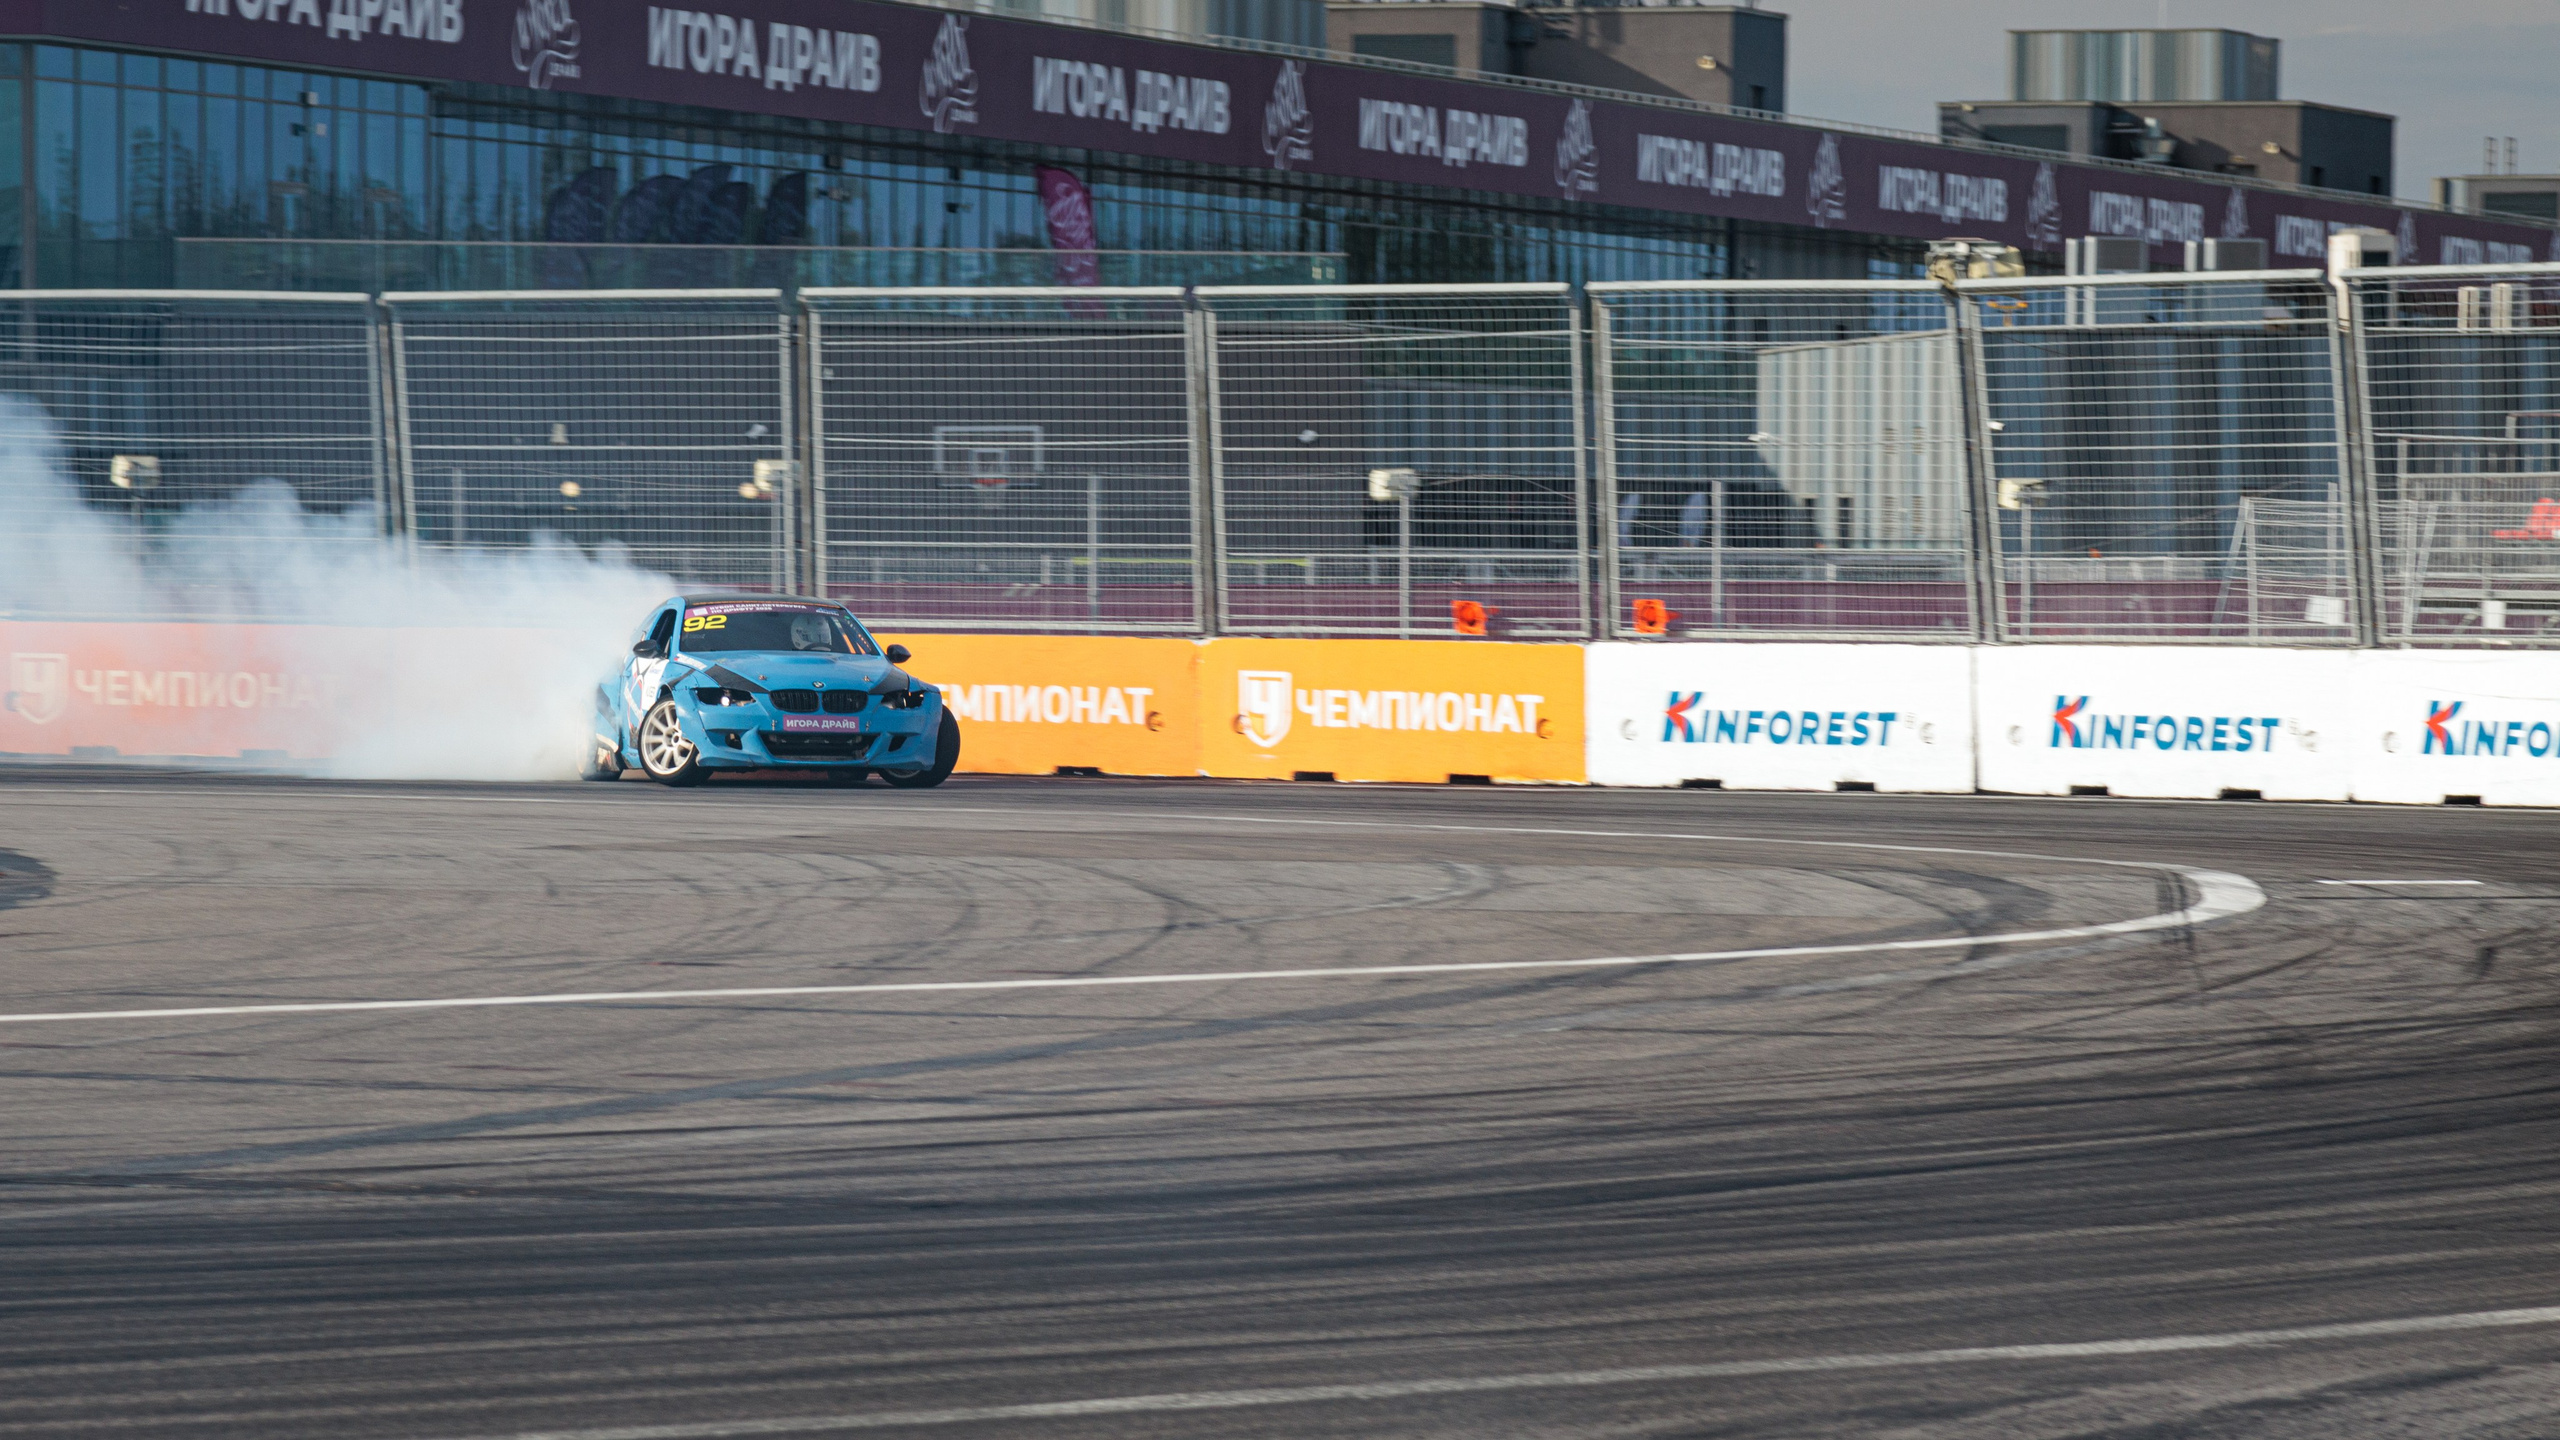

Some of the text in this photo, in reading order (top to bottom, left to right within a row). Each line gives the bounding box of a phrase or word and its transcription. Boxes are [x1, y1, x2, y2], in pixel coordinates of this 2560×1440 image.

[647, 5, 761, 79] ИГОРА
[1033, 56, 1130, 122] ИГОРА
[683, 615, 727, 632] 92
[786, 718, 856, 729] ИГОРА ДРАЙВ
[1296, 688, 1545, 733] ЧЕМПИОНАТ
[1662, 691, 1899, 746] KINFOREST
[2050, 695, 2279, 752] KINFOREST
